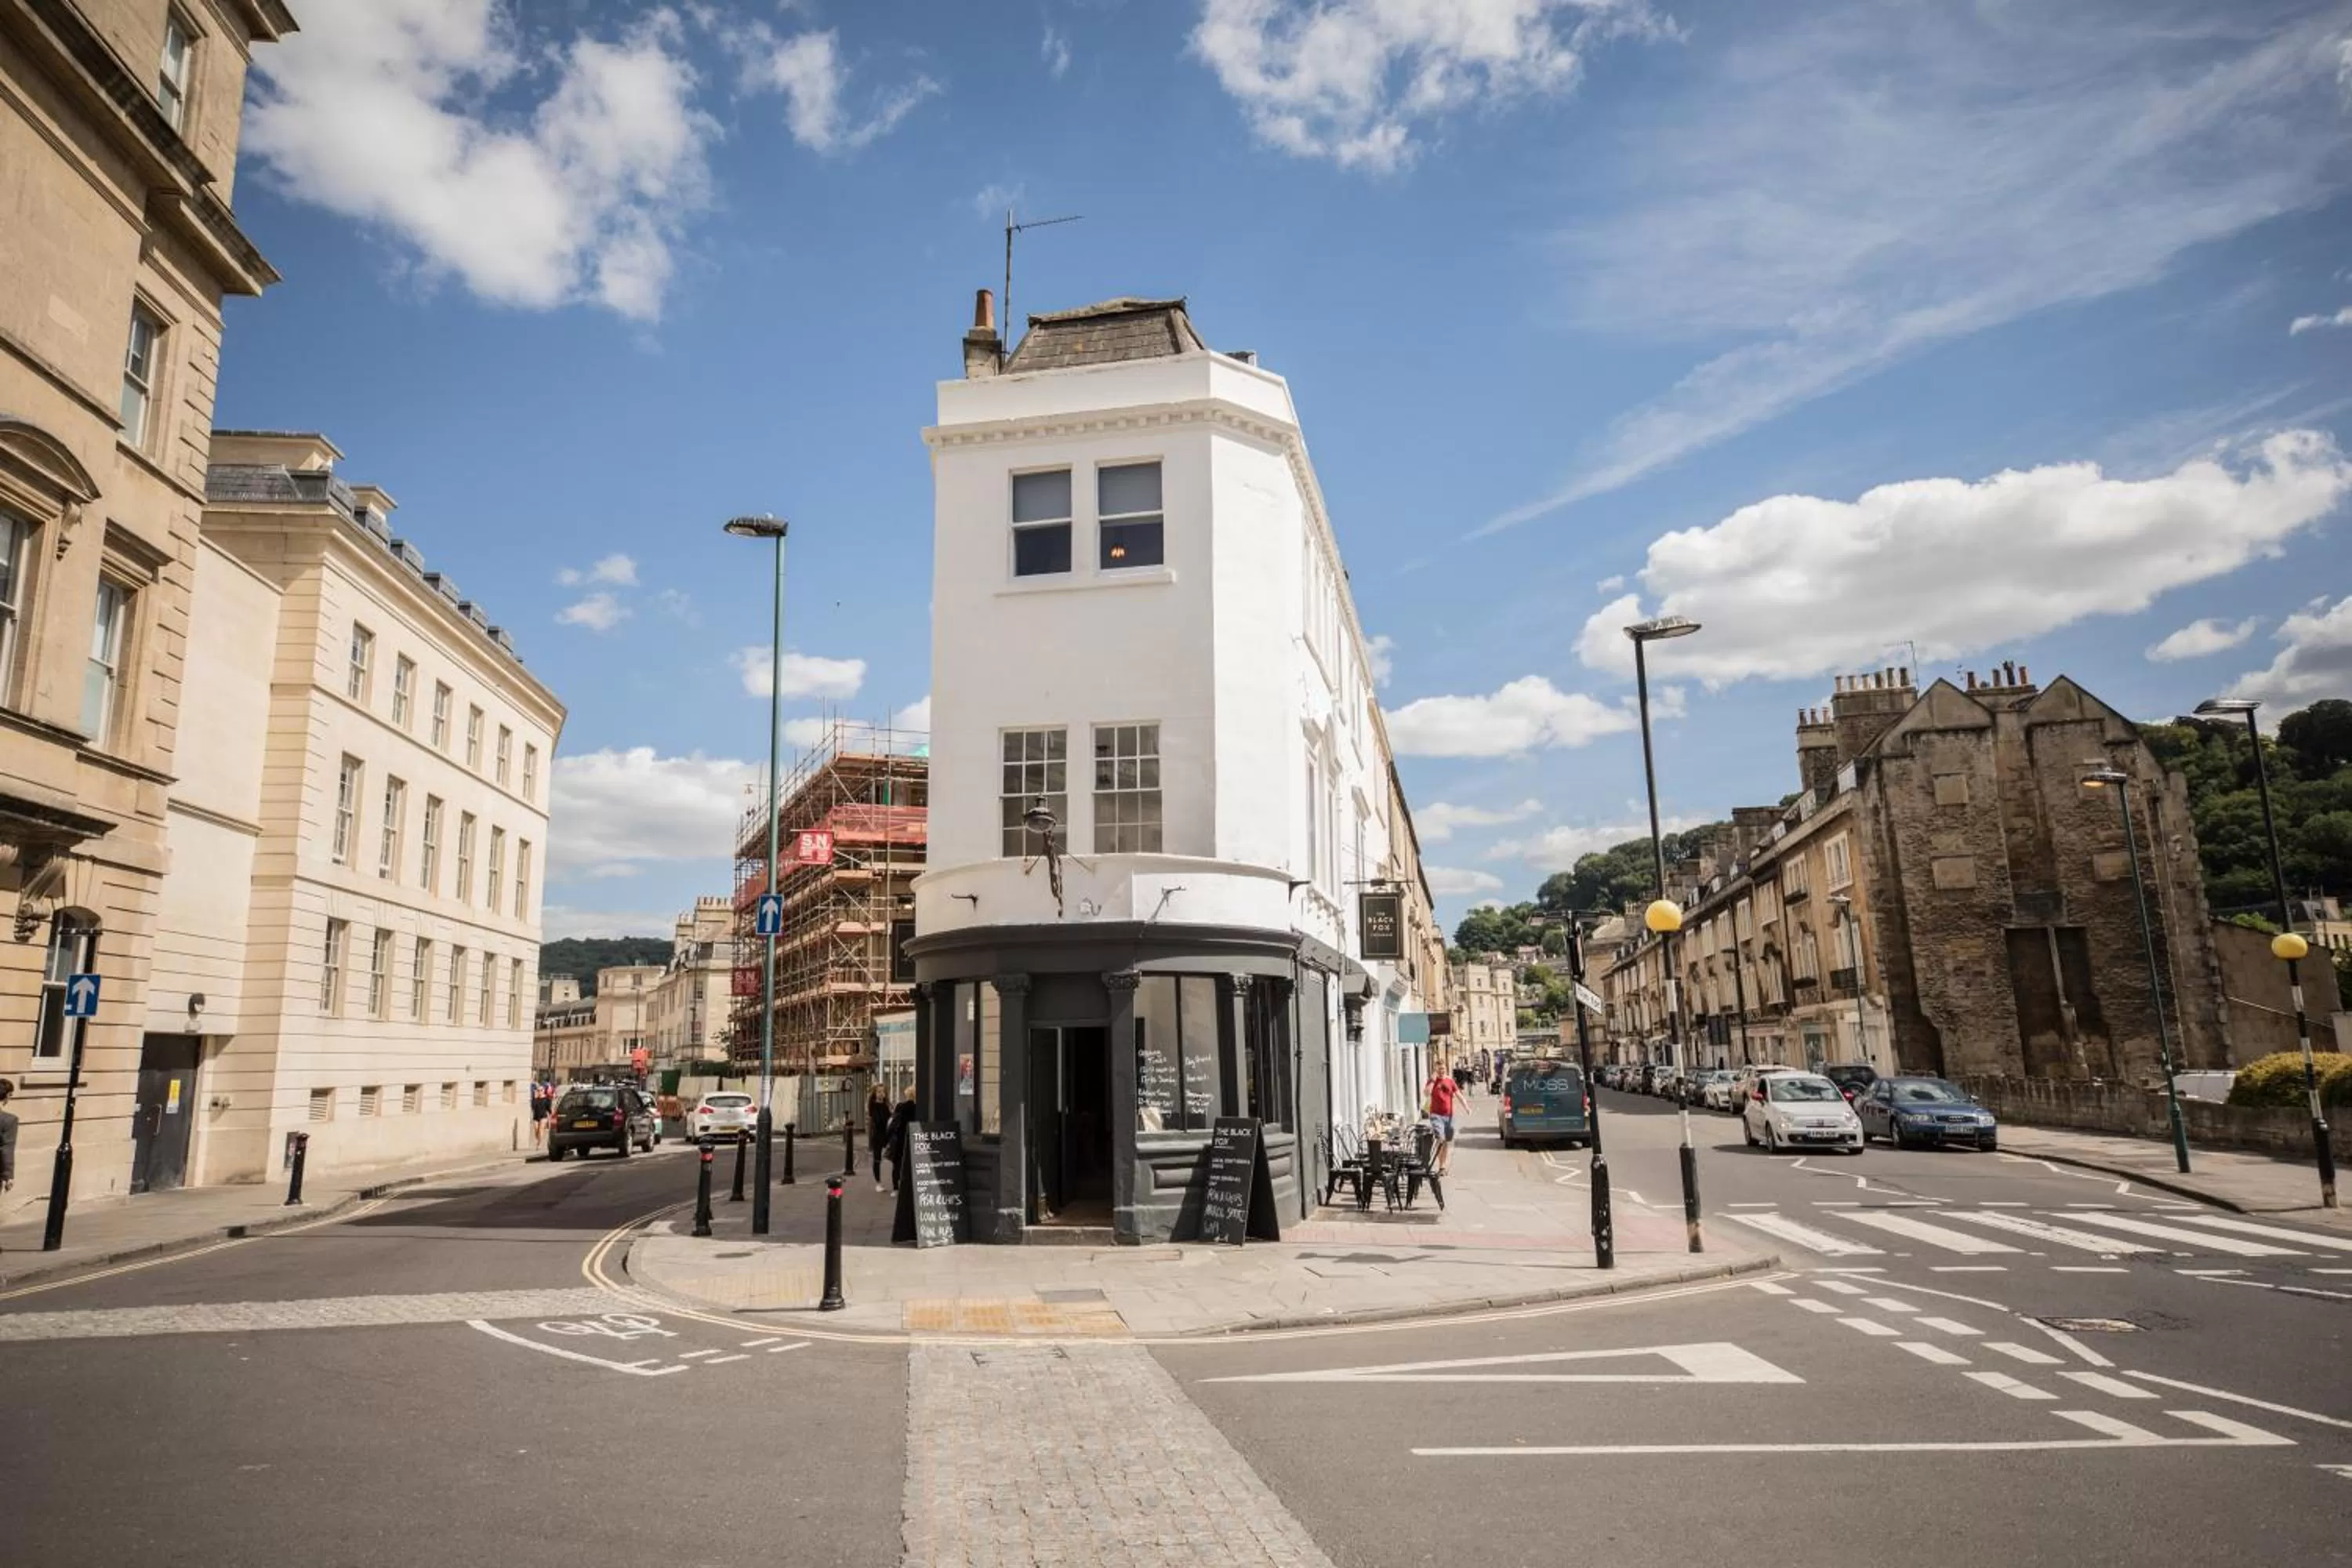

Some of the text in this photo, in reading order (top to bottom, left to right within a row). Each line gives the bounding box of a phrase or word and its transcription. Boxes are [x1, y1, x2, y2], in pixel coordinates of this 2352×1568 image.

[1523, 1078, 1569, 1091] MOSS
[913, 1131, 957, 1142] THE BLACK
[1216, 1127, 1253, 1137] THE BLACK
[915, 1142, 932, 1152] FOX
[1214, 1138, 1230, 1146] FOX
